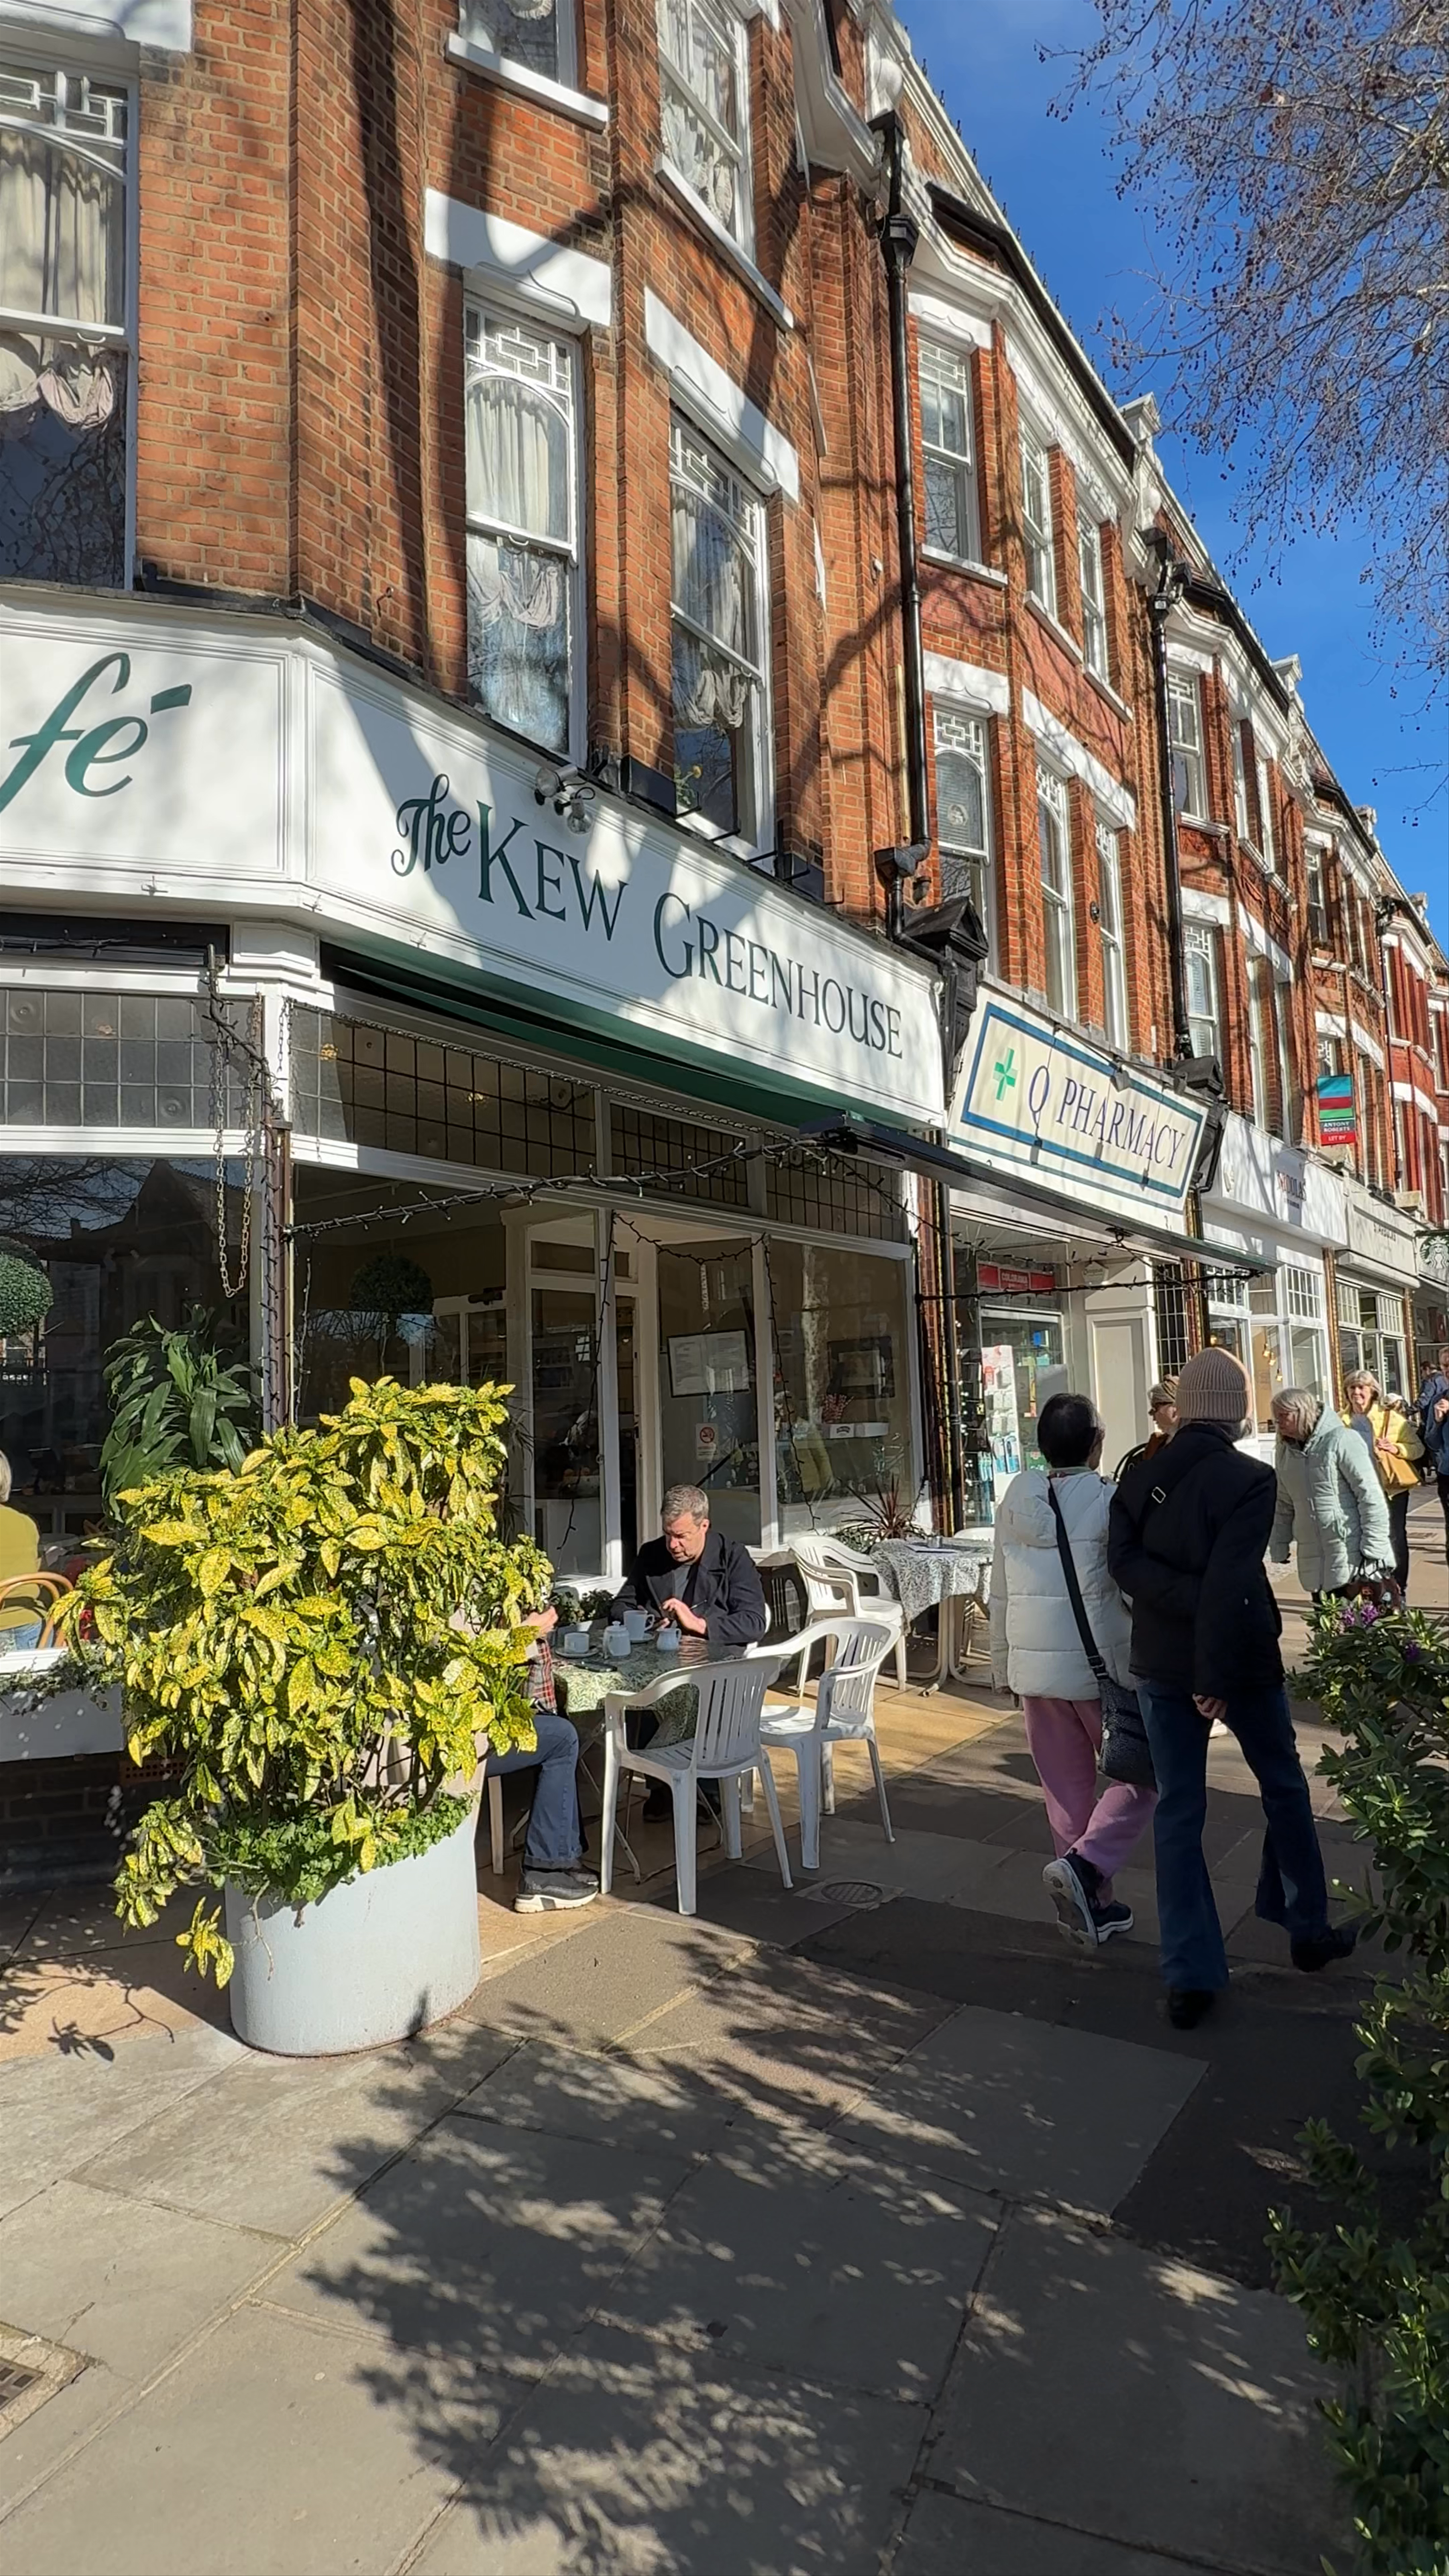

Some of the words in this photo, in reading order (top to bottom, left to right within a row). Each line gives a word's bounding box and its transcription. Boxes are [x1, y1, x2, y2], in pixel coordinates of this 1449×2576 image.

[391, 774, 471, 877] The
[475, 800, 629, 941] KEW
[654, 892, 903, 1059] GREENHOUSE
[1028, 1065, 1050, 1126] Q
[1056, 1077, 1185, 1169] PHARMACY
